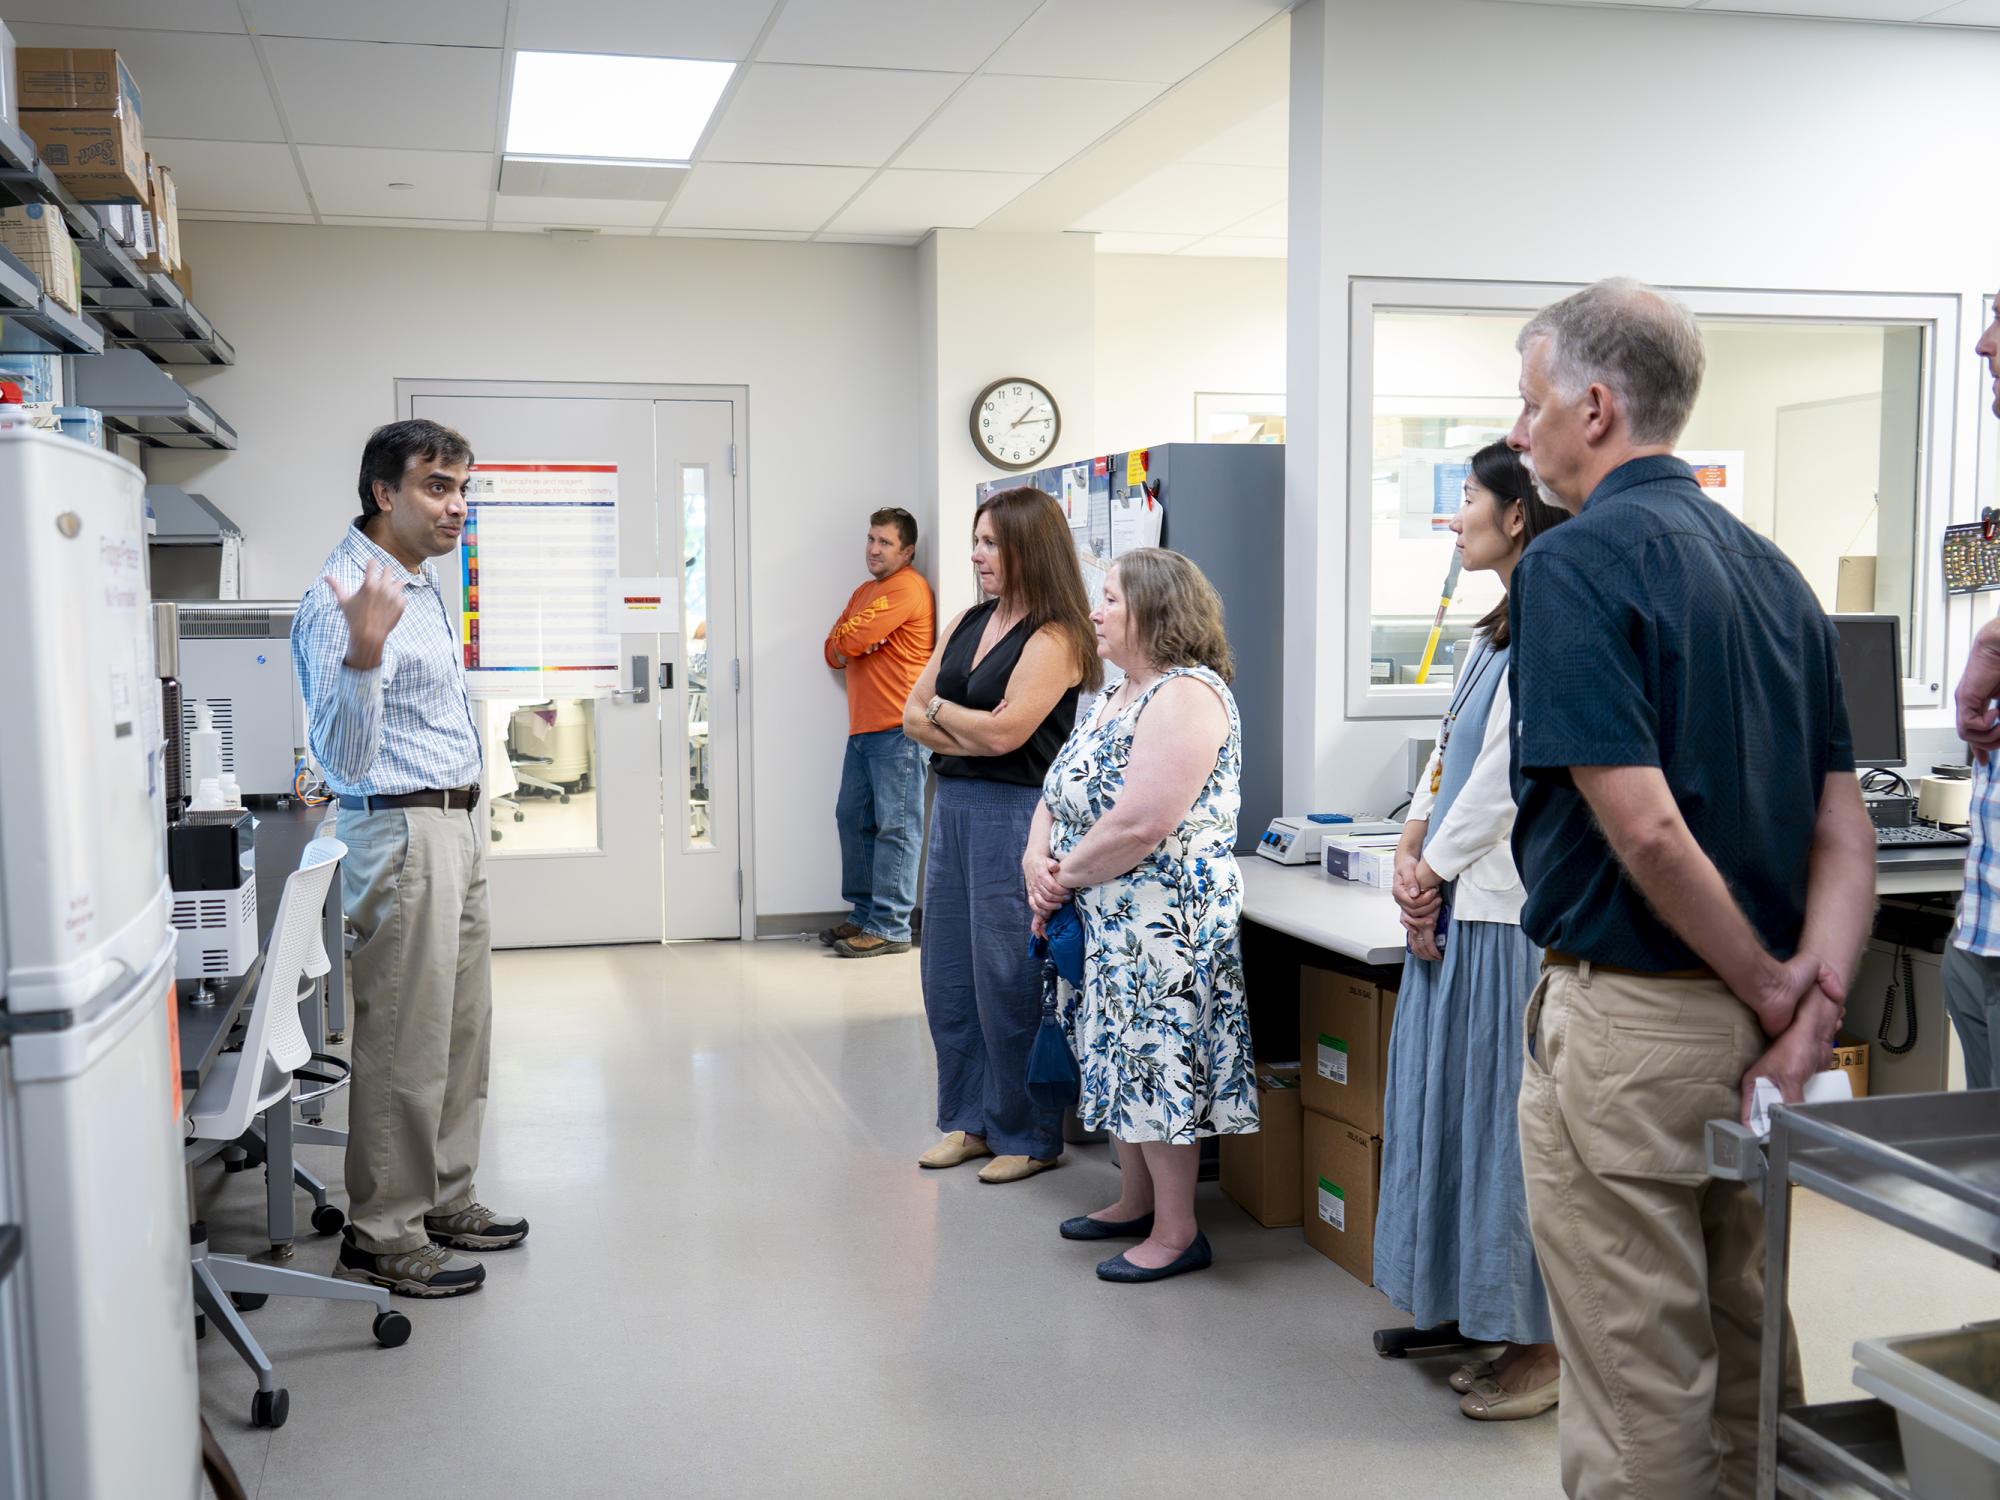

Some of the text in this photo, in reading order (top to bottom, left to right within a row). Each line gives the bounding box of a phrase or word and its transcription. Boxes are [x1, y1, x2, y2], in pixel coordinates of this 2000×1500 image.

[79, 139, 112, 165] Scott
[998, 391, 1005, 399] 11
[1012, 386, 1022, 396] 12
[1030, 391, 1034, 400] 1
[984, 402, 995, 411] 10
[983, 418, 990, 428] 9
[1043, 419, 1050, 429] 3
[987, 434, 994, 444] 8
[1039, 435, 1046, 443] 4
[999, 447, 1005, 456] 7
[1013, 451, 1020, 460] 6
[1029, 447, 1036, 456] 5
